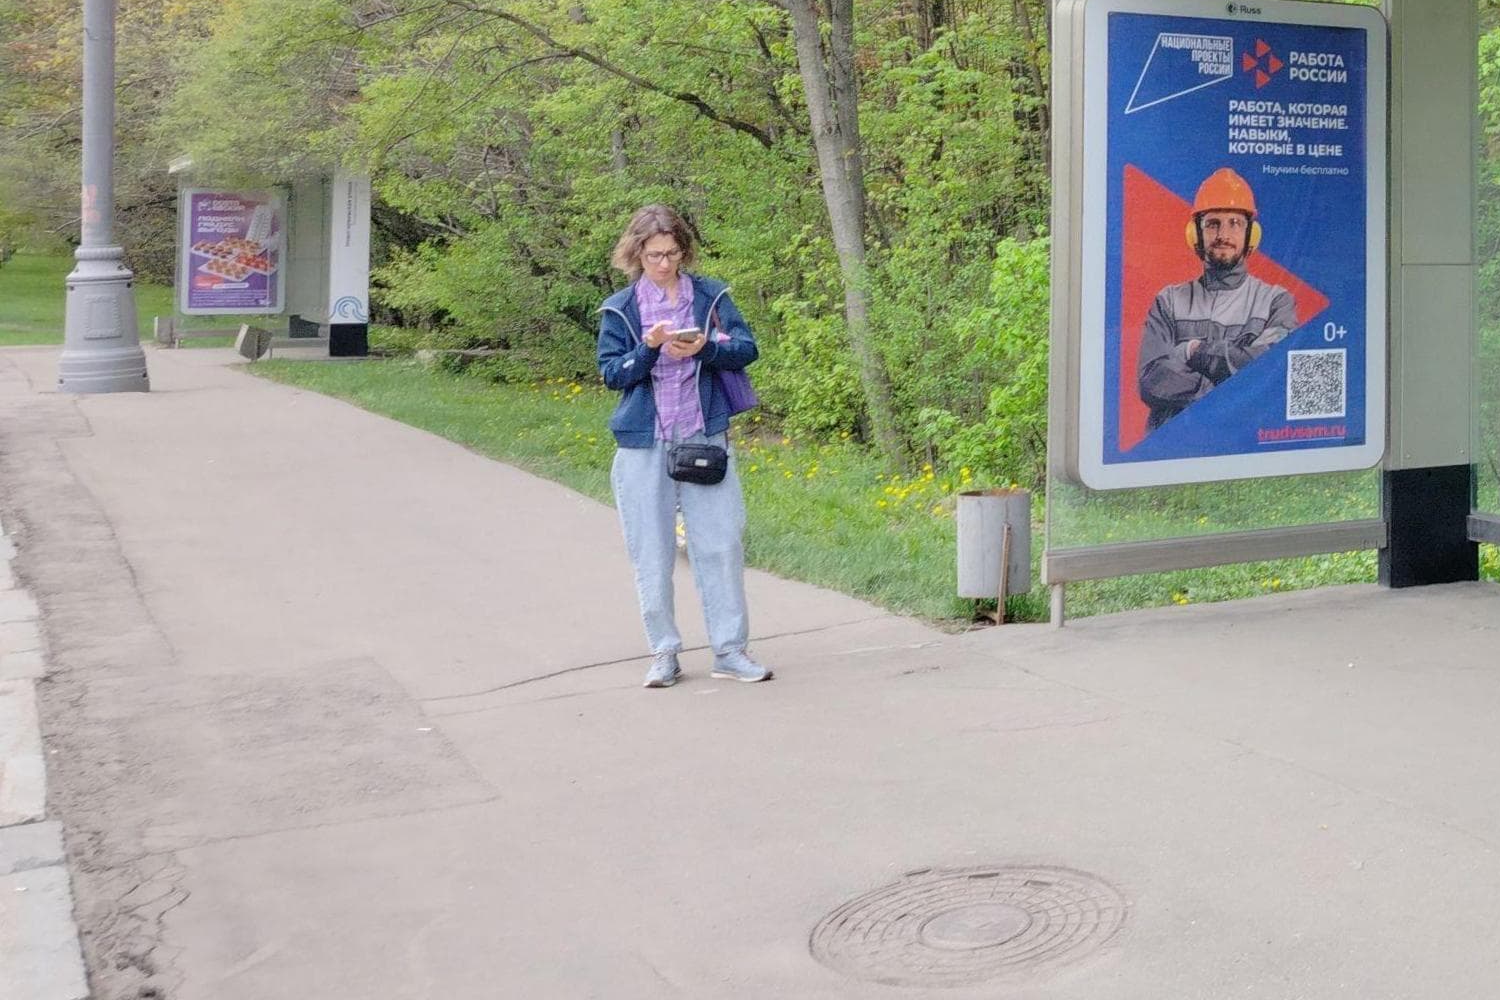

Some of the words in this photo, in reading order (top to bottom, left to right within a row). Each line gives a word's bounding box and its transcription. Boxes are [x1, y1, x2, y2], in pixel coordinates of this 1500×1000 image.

[1240, 5, 1262, 15] Russ
[1161, 36, 1231, 51] НАЦИОНАЛЬНЫЕ
[1191, 49, 1231, 63] ПРОЕКТЫ
[1290, 51, 1345, 68] РАБОТА
[1198, 62, 1231, 75] РОССИИ
[1289, 67, 1347, 83] РОССИИ
[1229, 100, 1286, 115] РАБОТА,
[1288, 103, 1348, 116] КОТОРАЯ
[1228, 114, 1275, 127] ИМЕЕТ
[1277, 116, 1349, 130] ЗНАЧЕНИЕ.
[1228, 128, 1292, 142] НАВЫКИ,
[1228, 142, 1294, 155] КОТОРЫЕ
[1296, 144, 1306, 156] В
[1308, 144, 1343, 157] ЦЕНЕ
[1262, 164, 1299, 176] Научим
[1300, 164, 1349, 176] бесплатно
[1323, 321, 1348, 342] 0+
